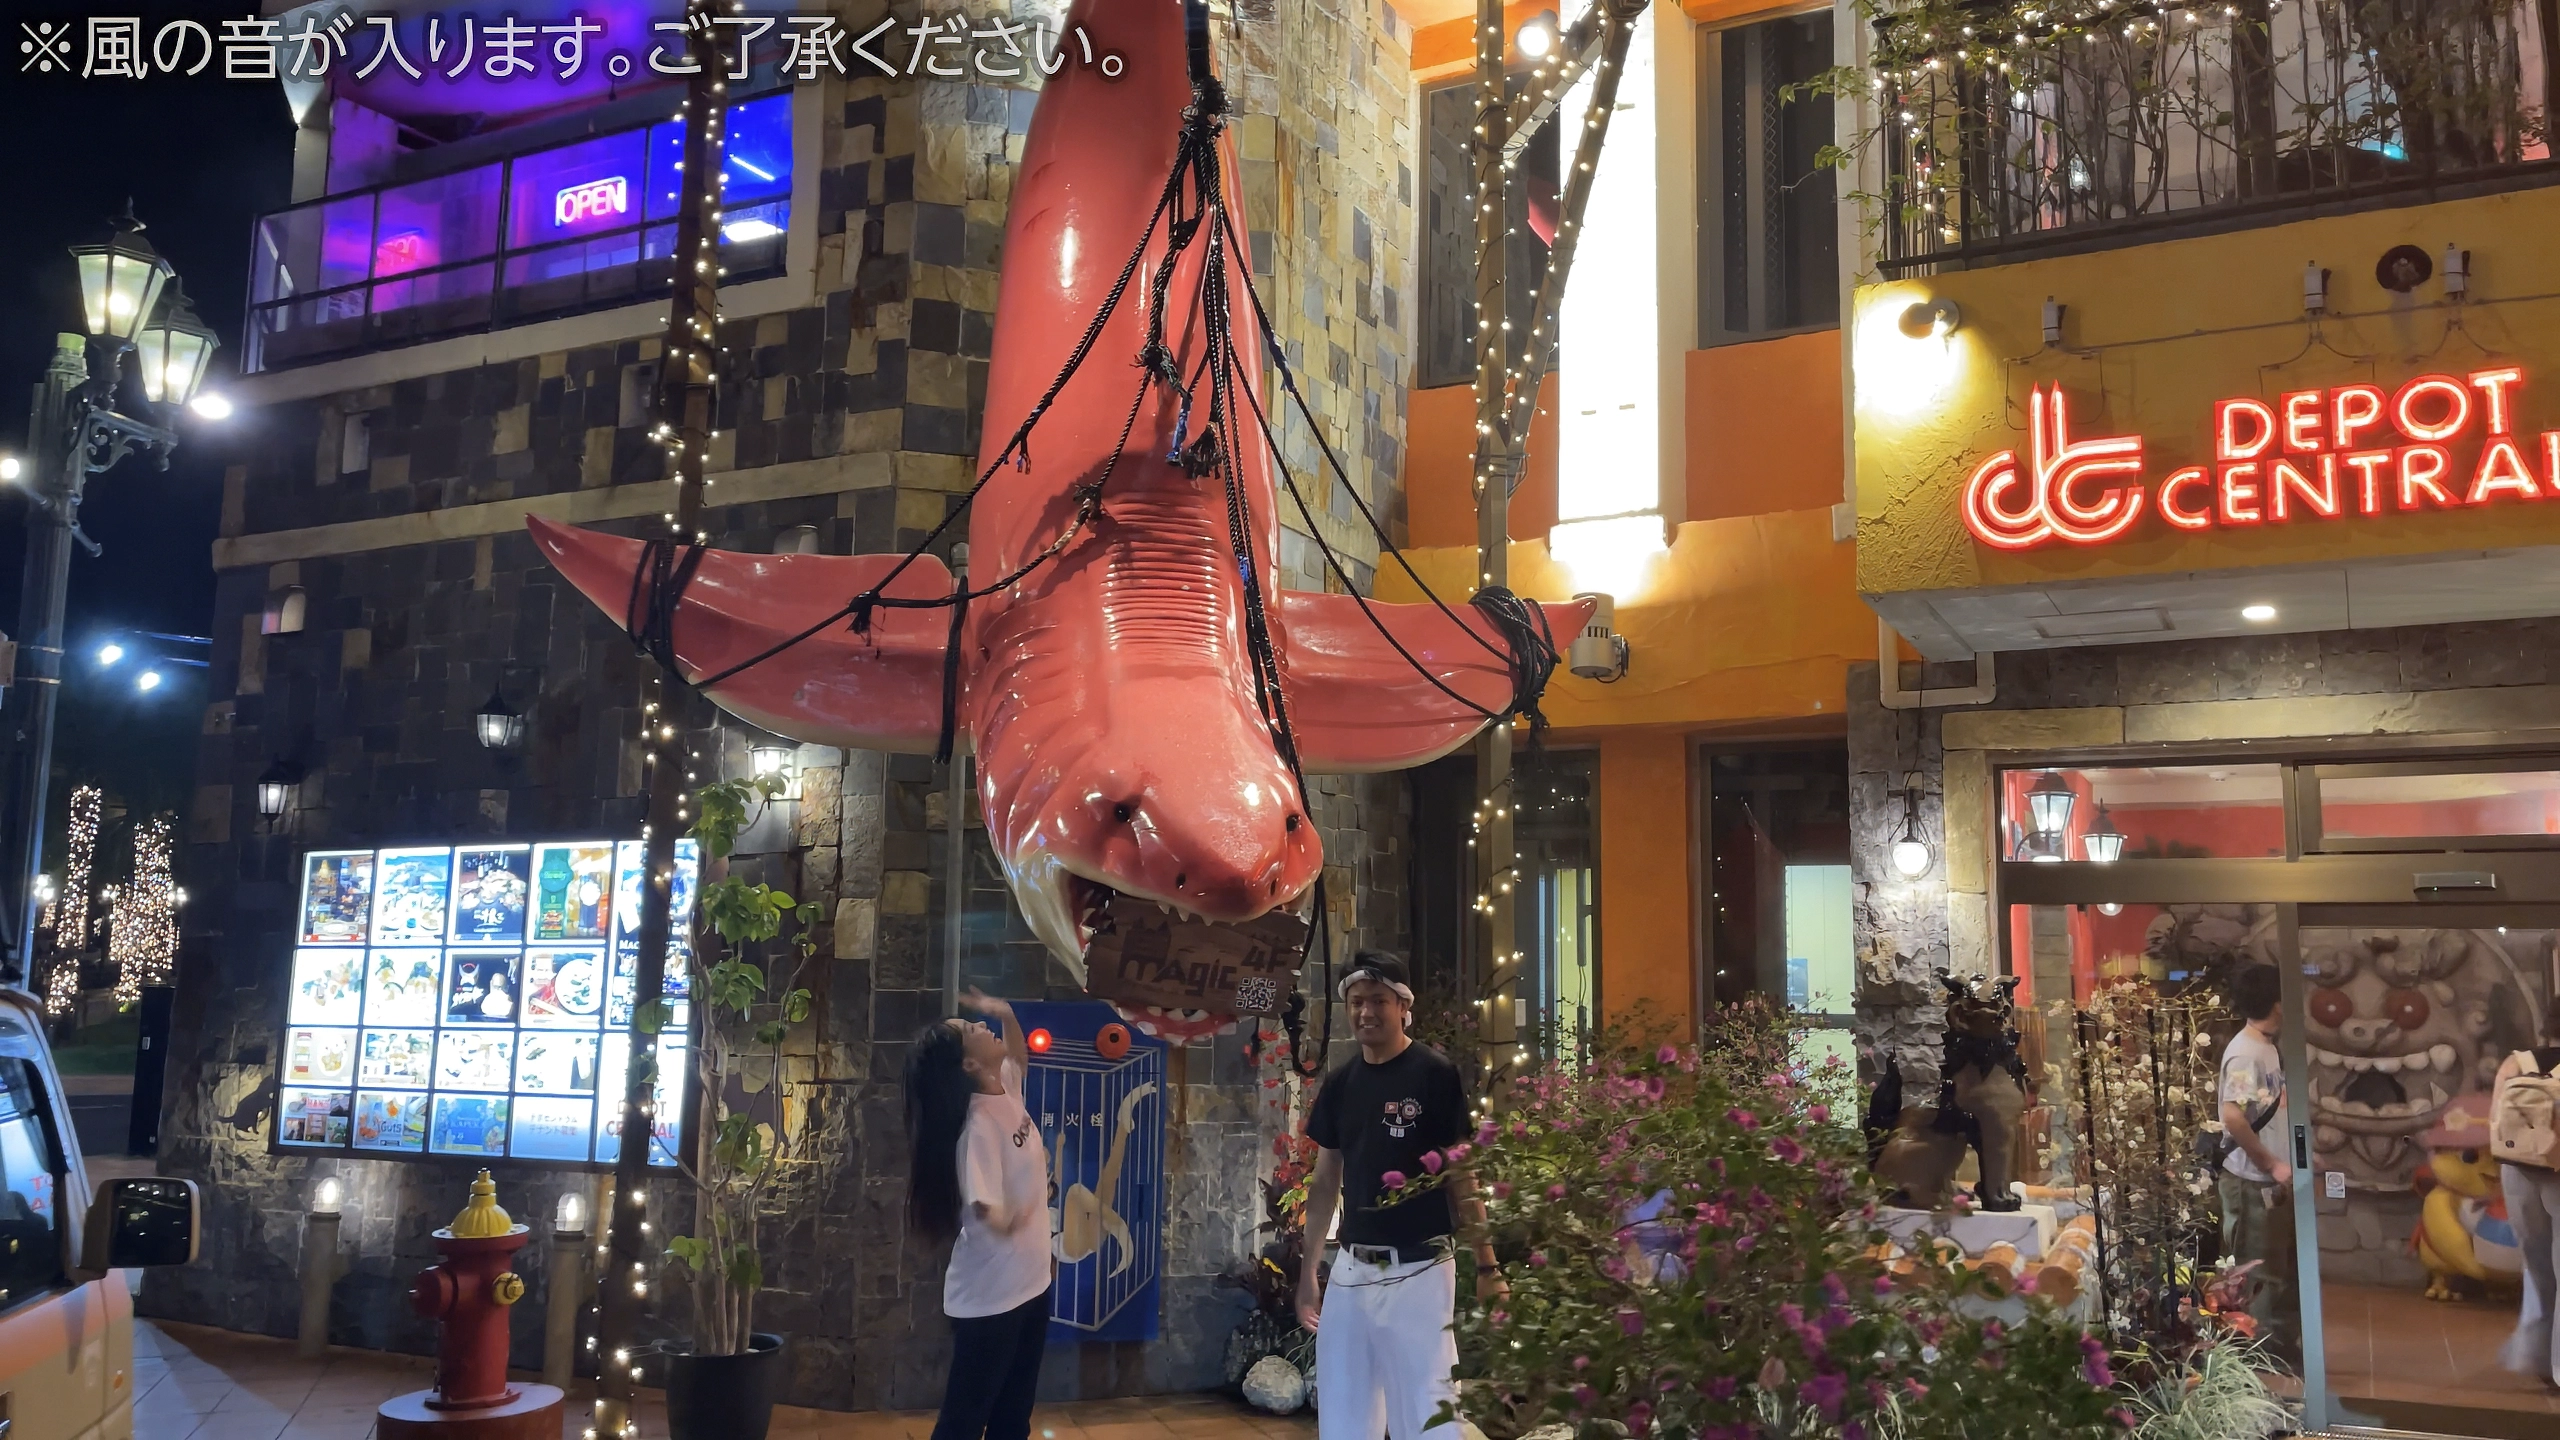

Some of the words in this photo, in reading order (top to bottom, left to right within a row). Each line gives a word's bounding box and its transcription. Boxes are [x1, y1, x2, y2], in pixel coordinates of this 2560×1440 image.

[559, 183, 626, 223] OPEN
[2214, 367, 2521, 462] DEPOT
[617, 1099, 667, 1117] DOT
[606, 1120, 676, 1139] CEAL
